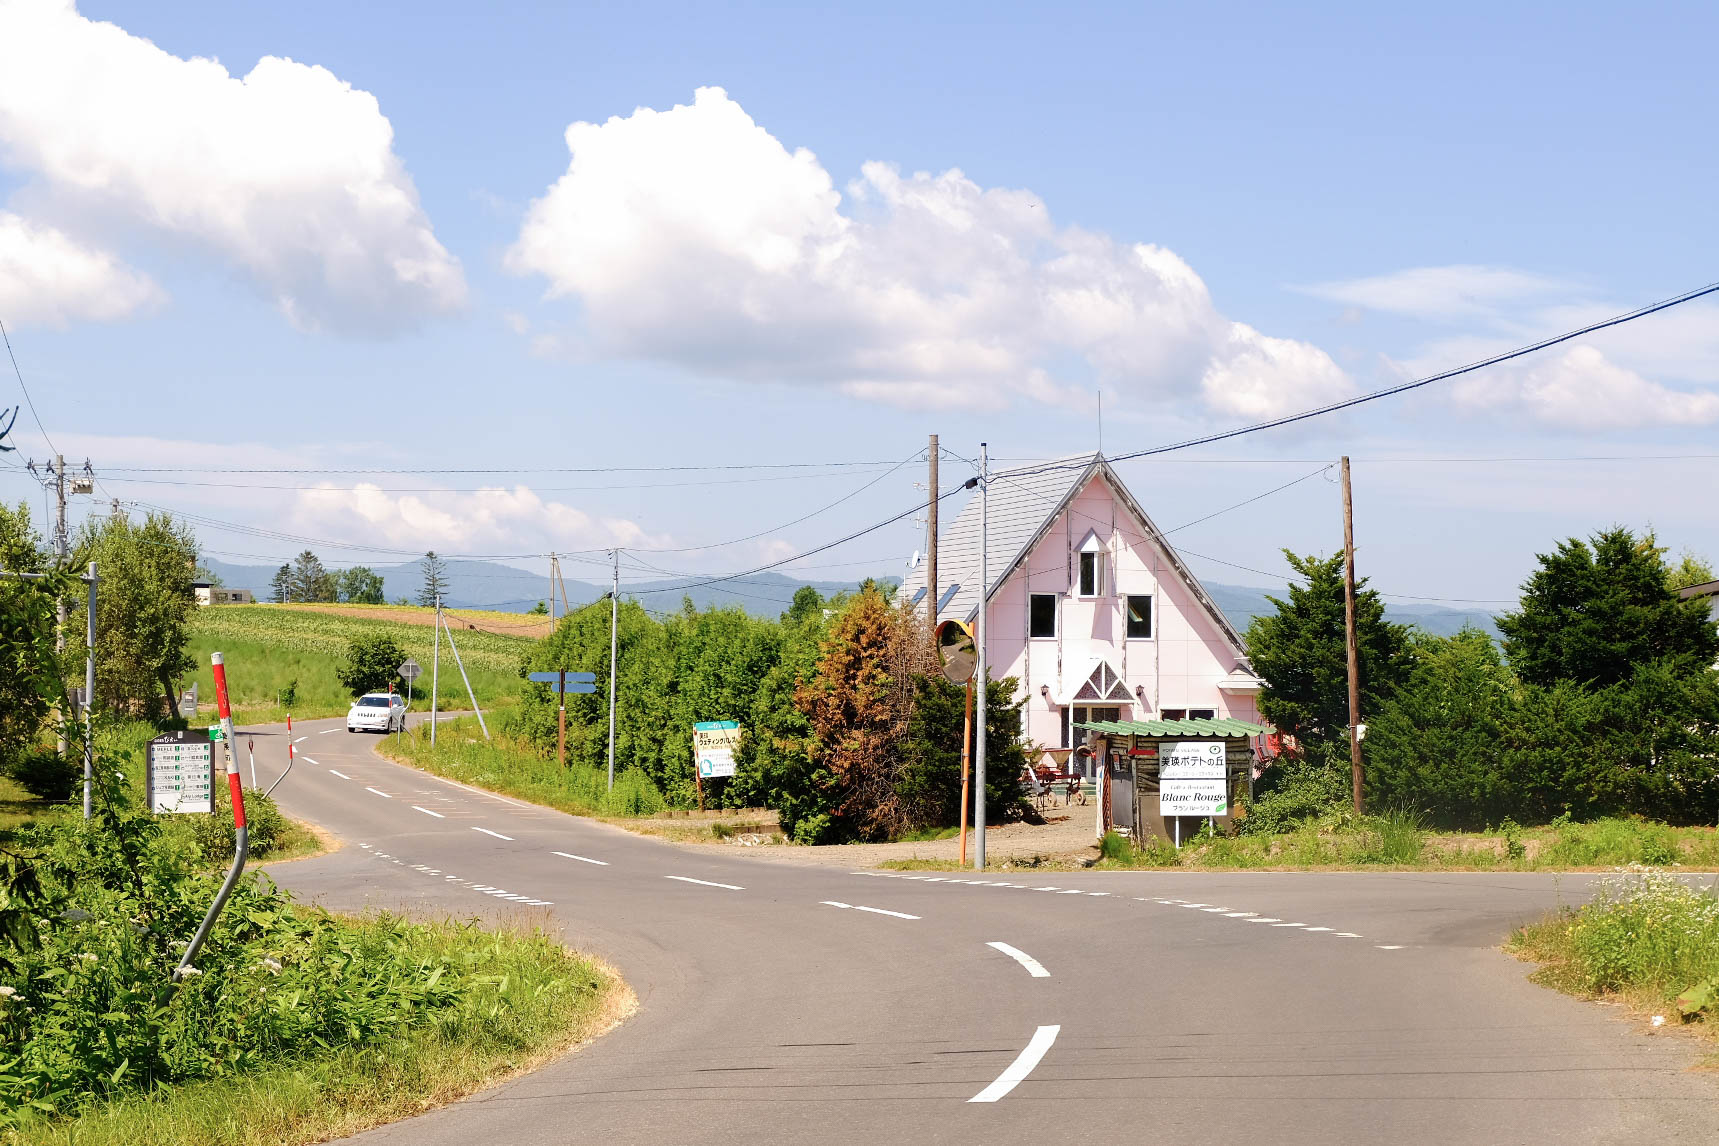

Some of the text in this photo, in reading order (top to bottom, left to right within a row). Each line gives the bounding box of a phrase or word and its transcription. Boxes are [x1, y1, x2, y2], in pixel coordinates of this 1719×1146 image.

[1161, 755, 1224, 766] 美瑛ポテトの丘
[1161, 792, 1226, 802] Blanc Rouge
